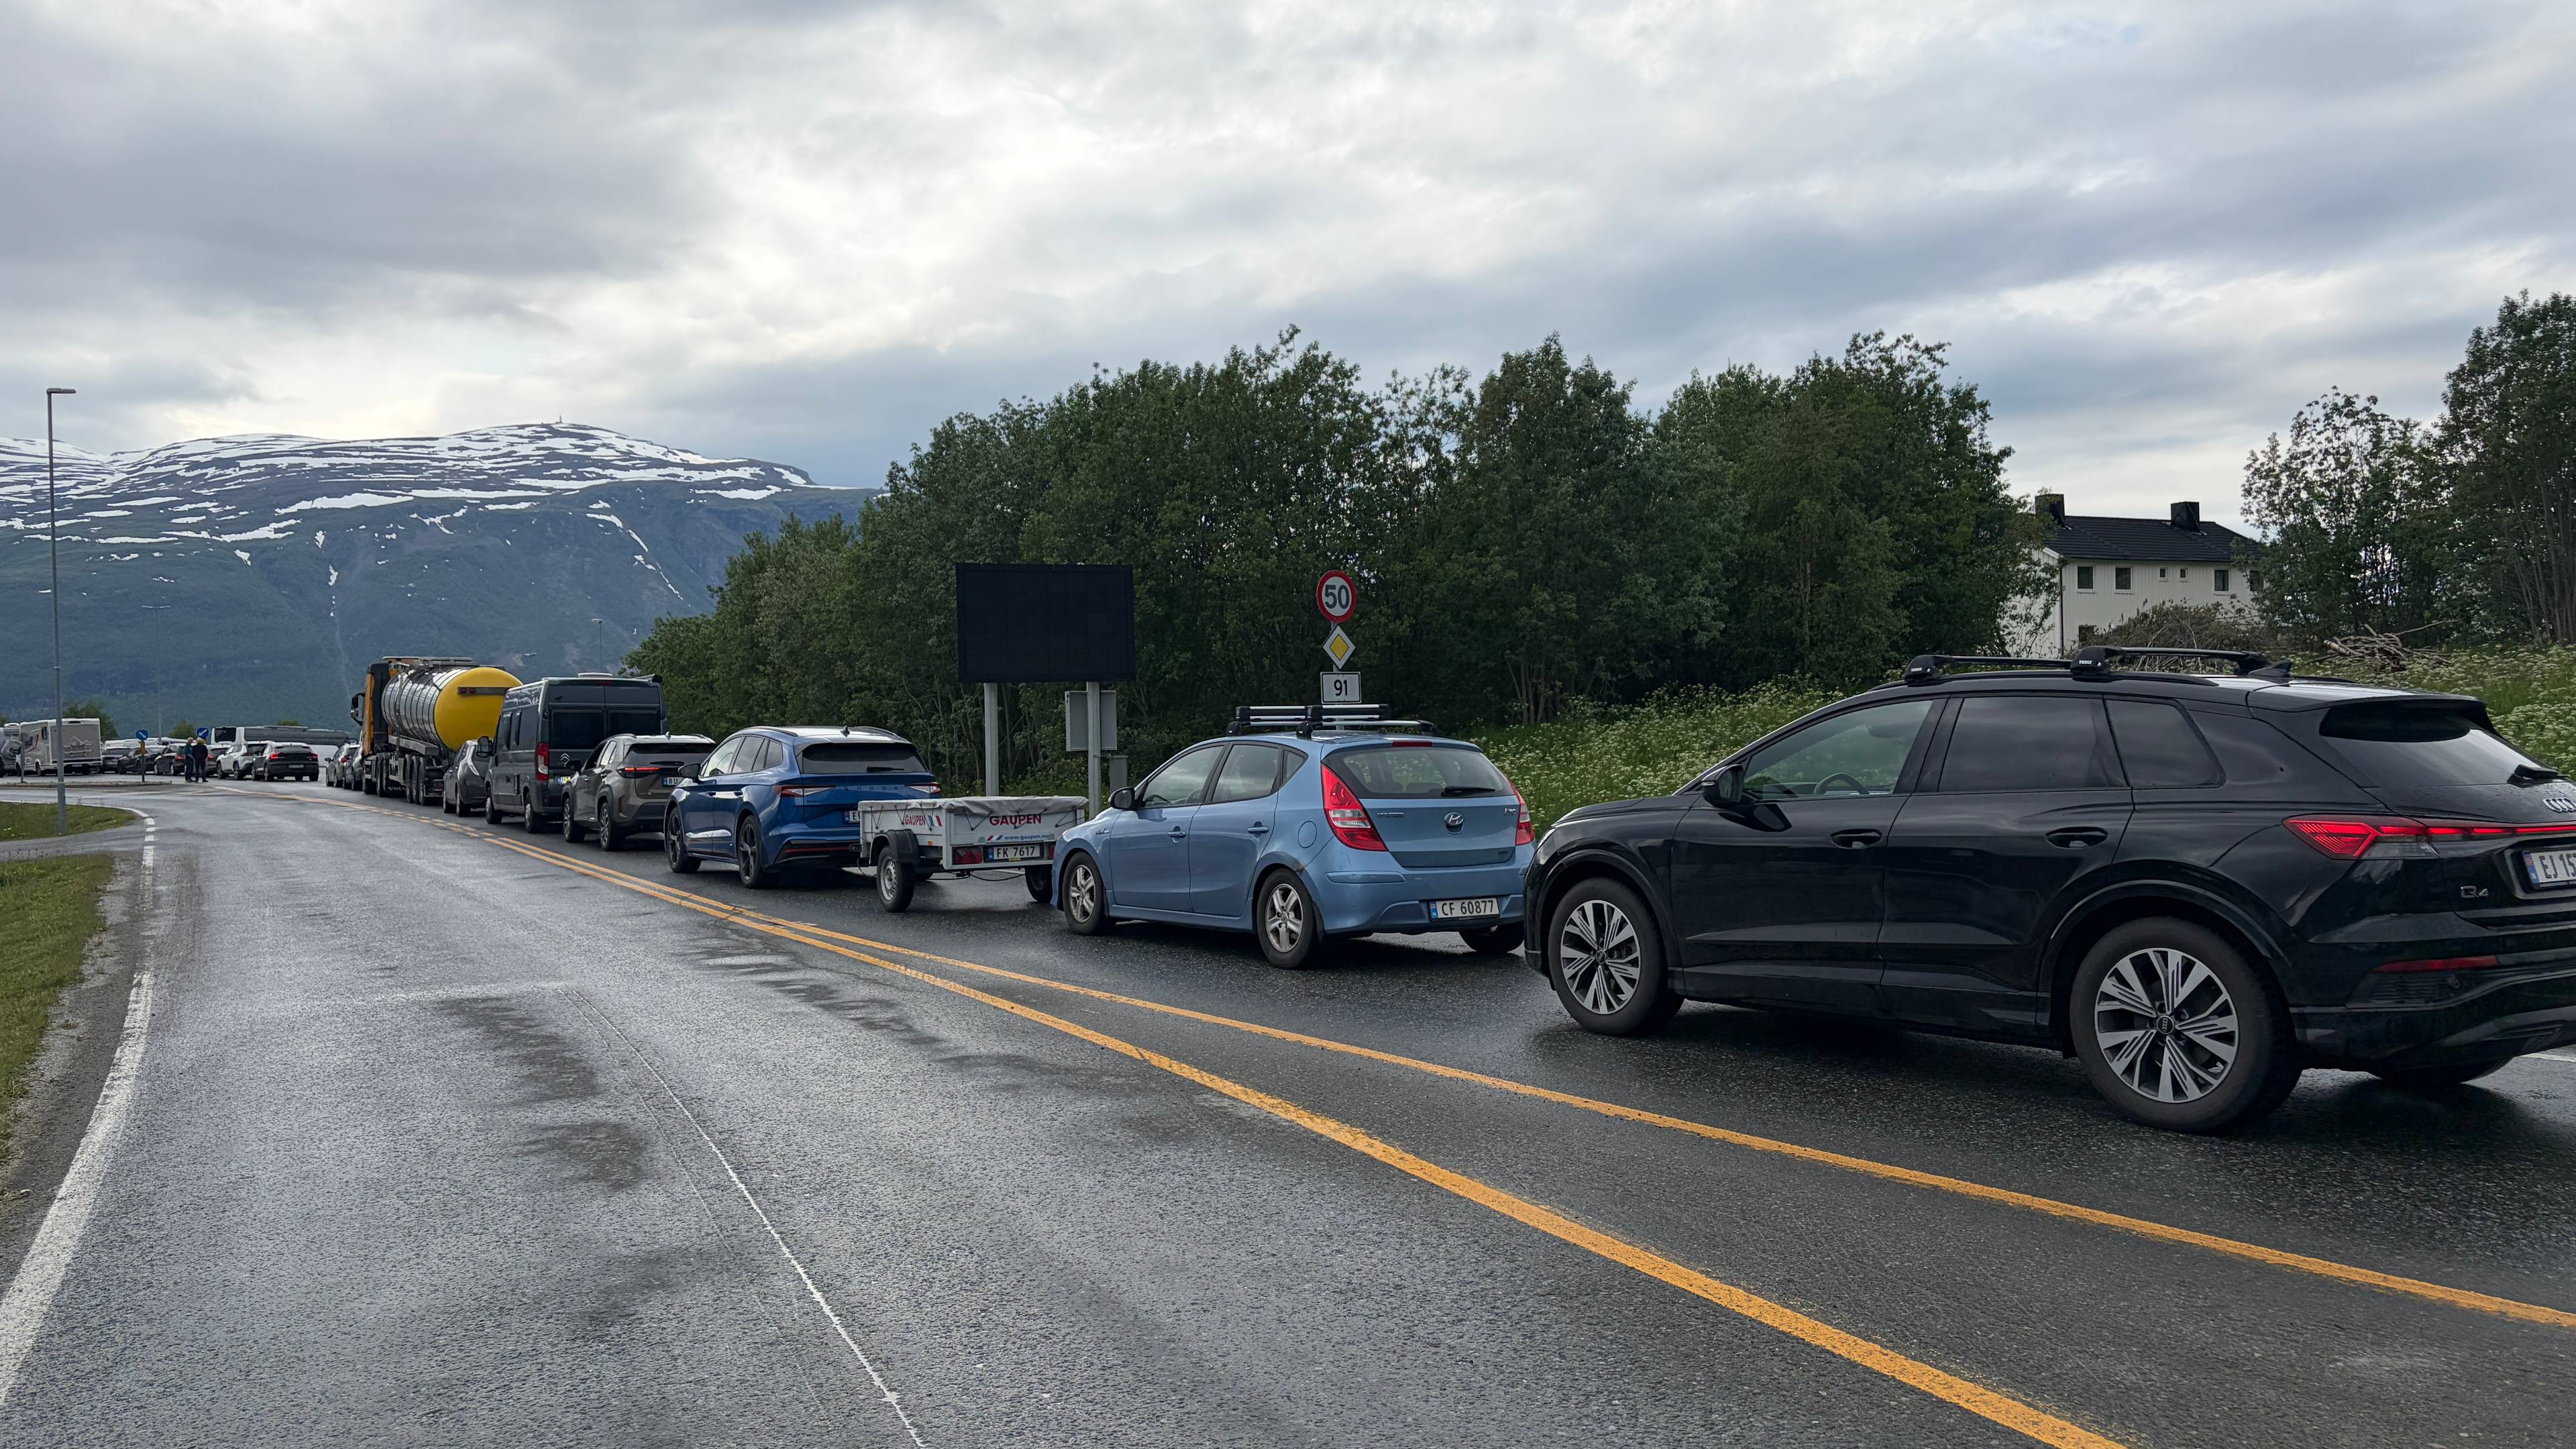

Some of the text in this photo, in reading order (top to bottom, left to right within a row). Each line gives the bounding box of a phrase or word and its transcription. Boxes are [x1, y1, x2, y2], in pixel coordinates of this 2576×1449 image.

[1324, 584, 1350, 610] 50
[1334, 679, 1348, 697] 91
[905, 814, 926, 826] GAUPEN
[989, 814, 1042, 826] GAUPEN
[997, 846, 1035, 859] FK 7617
[2538, 855, 2559, 879] EJ
[1441, 900, 1494, 916] CF 60877
